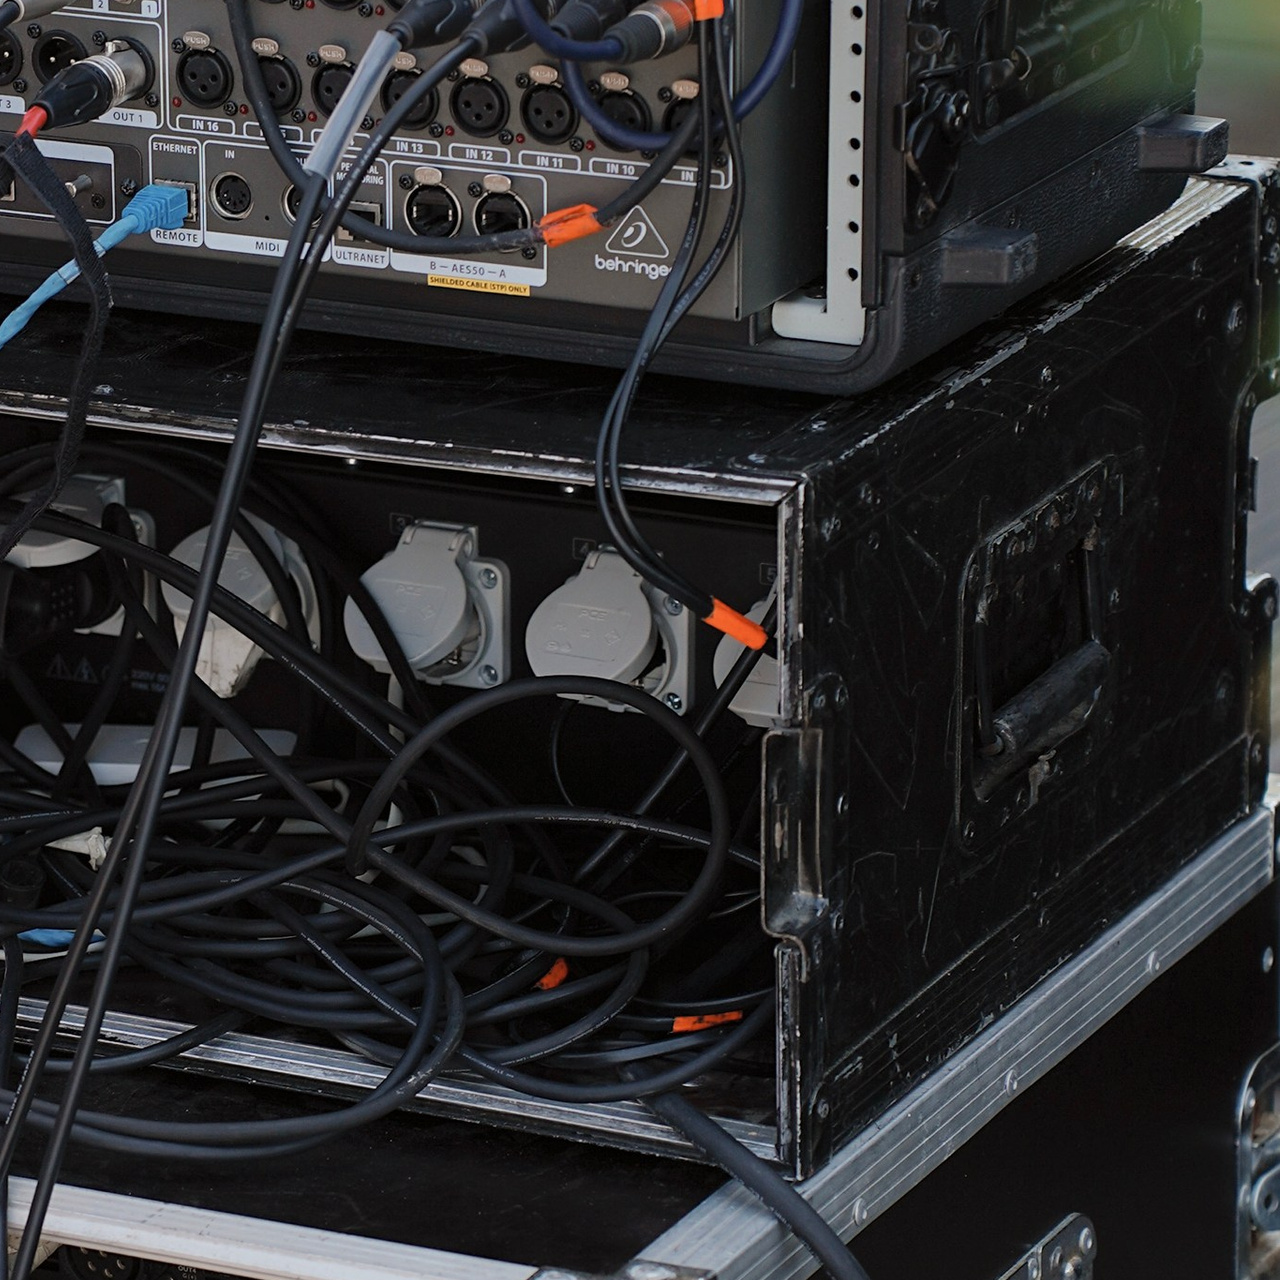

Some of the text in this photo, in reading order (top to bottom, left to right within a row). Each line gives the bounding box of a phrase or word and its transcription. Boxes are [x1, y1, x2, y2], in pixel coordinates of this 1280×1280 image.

[113, 111, 133, 122] OUT
[192, 120, 219, 132] IN 16
[152, 141, 198, 155] ETHERNET
[396, 141, 423, 154] IN 13
[225, 150, 235, 159] IN
[465, 148, 493, 161] IN 12
[536, 155, 563, 168] IN 11
[606, 162, 635, 175] IN 10
[681, 170, 694, 181] IN
[155, 229, 198, 243] REMOTE
[255, 241, 280, 252] MIDI
[335, 250, 385, 265] ULTRANET
[451, 263, 485, 276] AES50
[430, 276, 528, 295] SHIELDED CABLE (STP) ONLY
